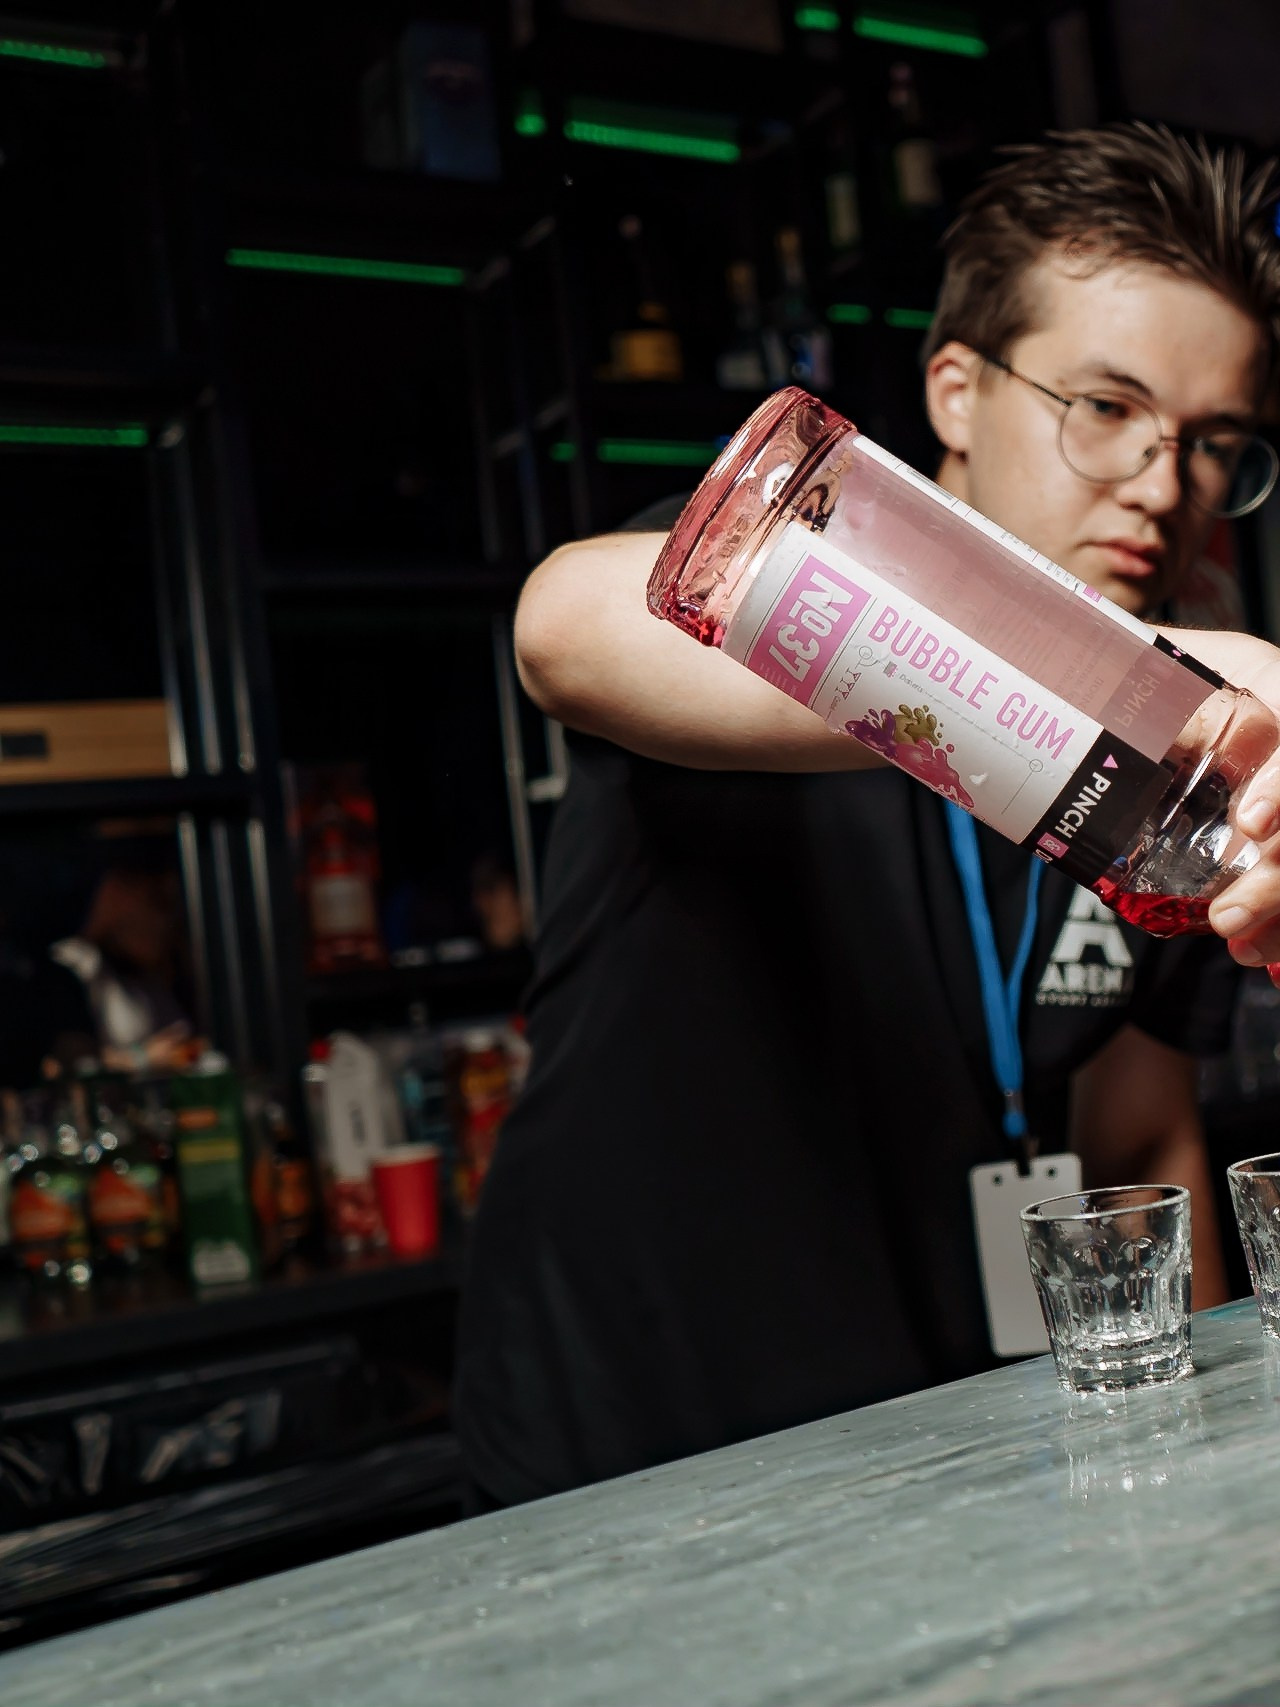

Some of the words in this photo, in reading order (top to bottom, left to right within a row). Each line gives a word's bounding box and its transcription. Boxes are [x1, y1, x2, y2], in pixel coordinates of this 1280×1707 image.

[867, 605, 1000, 711] BUBBLE
[995, 692, 1076, 761] GUM
[1054, 771, 1112, 839] PINCH
